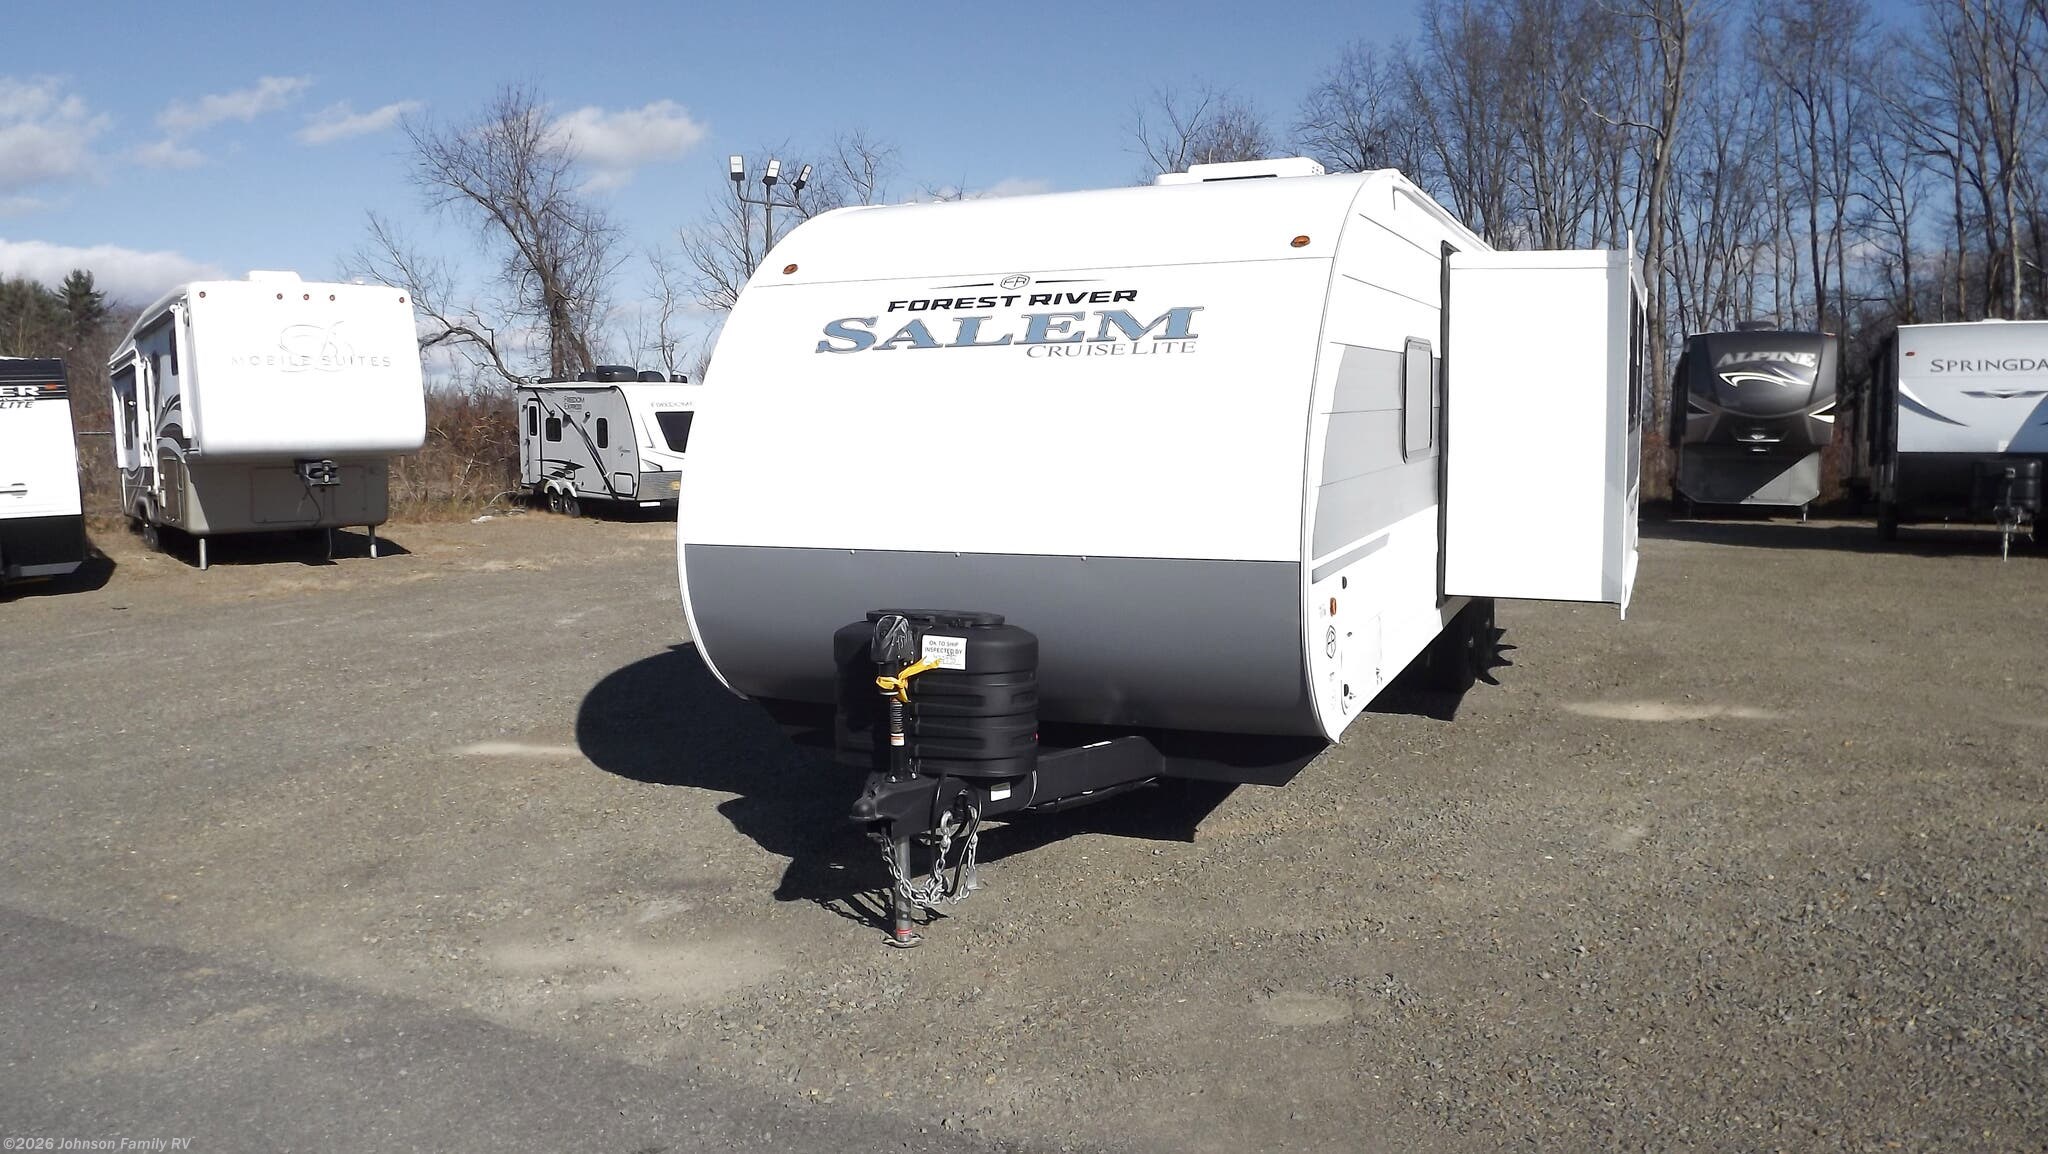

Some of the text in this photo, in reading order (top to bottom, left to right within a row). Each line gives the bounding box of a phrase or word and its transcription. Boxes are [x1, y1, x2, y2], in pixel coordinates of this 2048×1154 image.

[887, 289, 1139, 313] FOREST RIVER
[815, 305, 1205, 354] SALEM
[231, 354, 392, 368] MOBILE SUITES
[1715, 351, 1817, 369] ALPINE
[925, 647, 954, 655] INSPECTED
